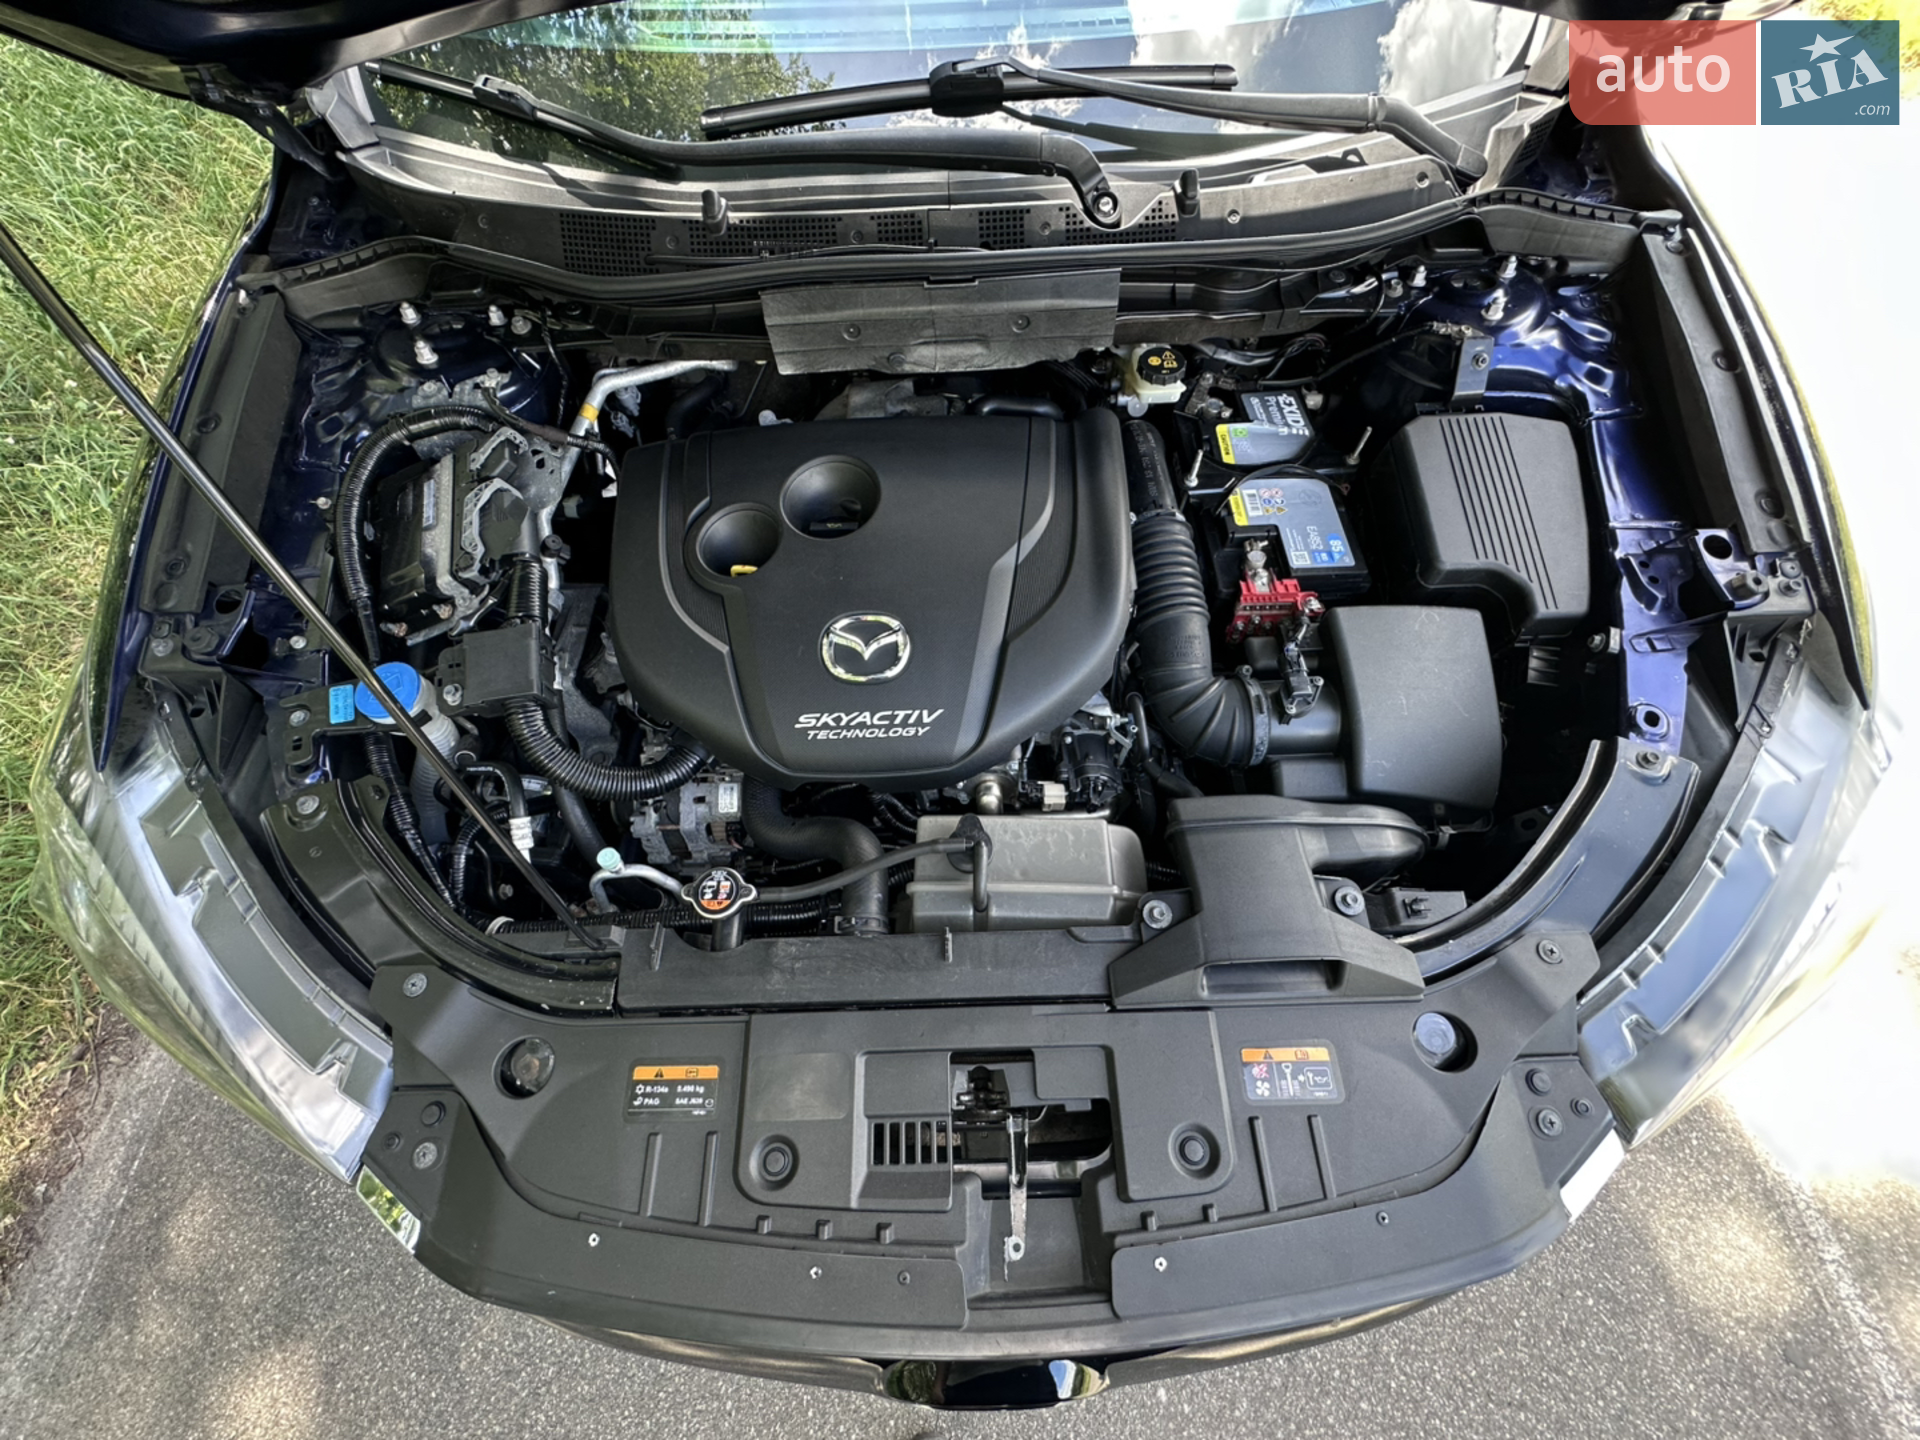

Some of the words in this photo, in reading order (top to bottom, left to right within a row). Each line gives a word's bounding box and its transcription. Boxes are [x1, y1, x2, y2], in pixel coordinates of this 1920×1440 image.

[1277, 394, 1310, 437] EXIDE
[1329, 540, 1344, 552] 85
[794, 709, 945, 728] SKYACTIV
[807, 726, 931, 740] TECHNOLOGY
